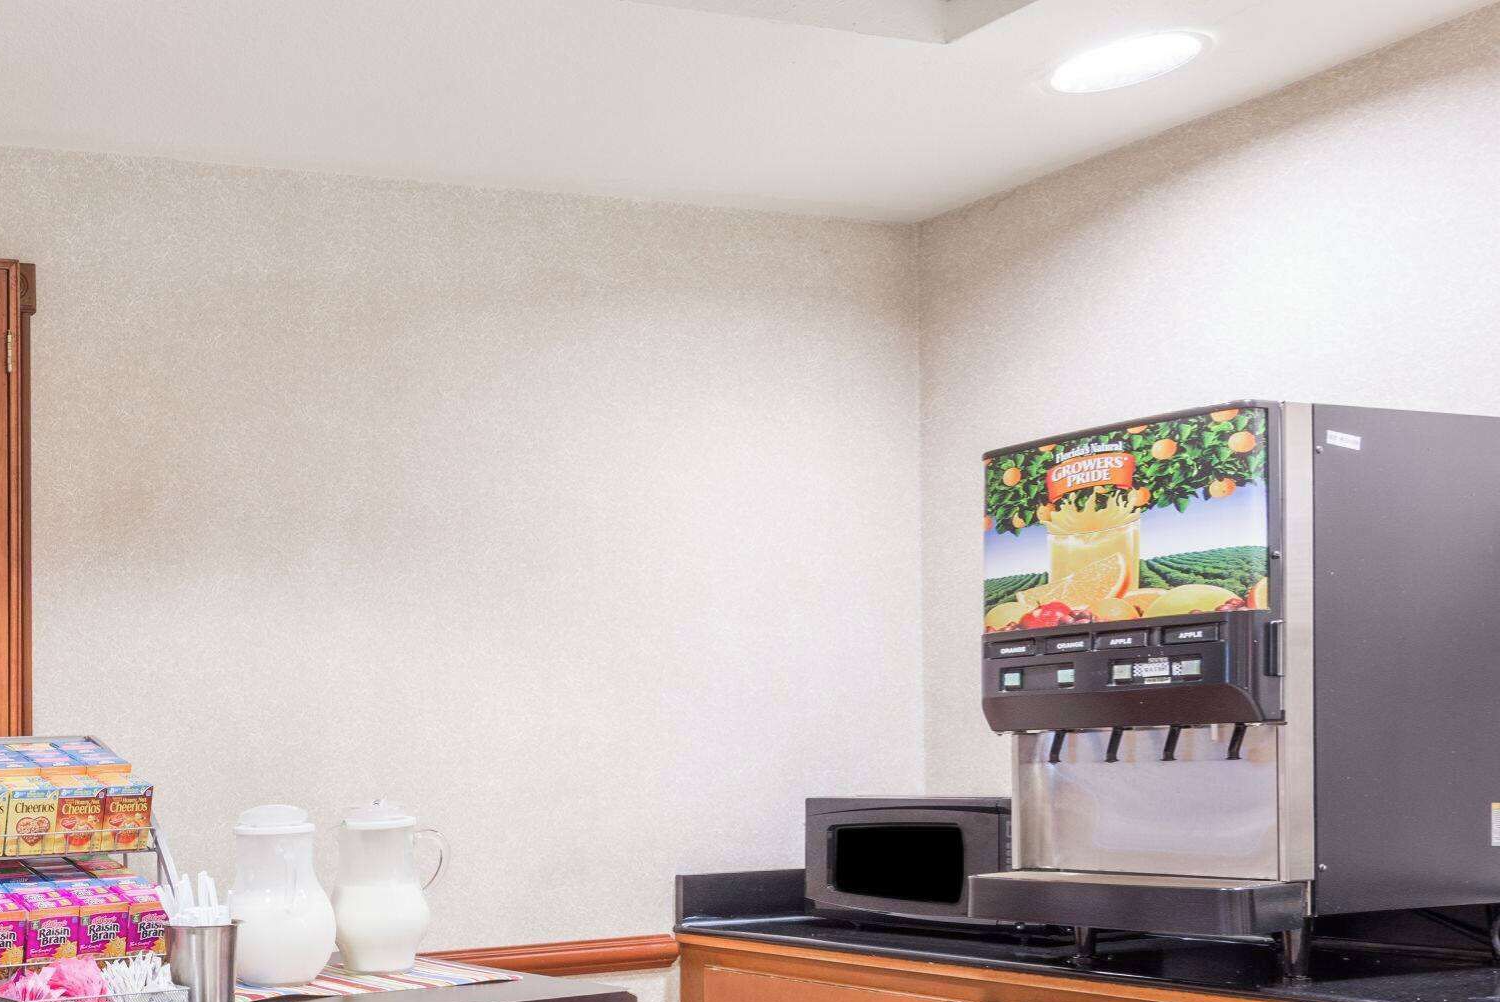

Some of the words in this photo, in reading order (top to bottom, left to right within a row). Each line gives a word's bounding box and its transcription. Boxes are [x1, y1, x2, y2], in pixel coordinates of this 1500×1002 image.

[1066, 469, 1111, 488] PRIDE
[1178, 631, 1203, 639] APPLE
[1056, 641, 1084, 650] ORANGE
[1109, 637, 1133, 646] APPLE
[14, 802, 55, 814] Cheerios
[62, 803, 101, 814] Cheerios
[109, 802, 148, 812] Cheerios
[38, 927, 70, 938] Raisin
[89, 924, 119, 934] Raisin
[141, 929, 164, 938] Bran
[41, 935, 66, 946] Bran
[91, 931, 116, 941] Bran
